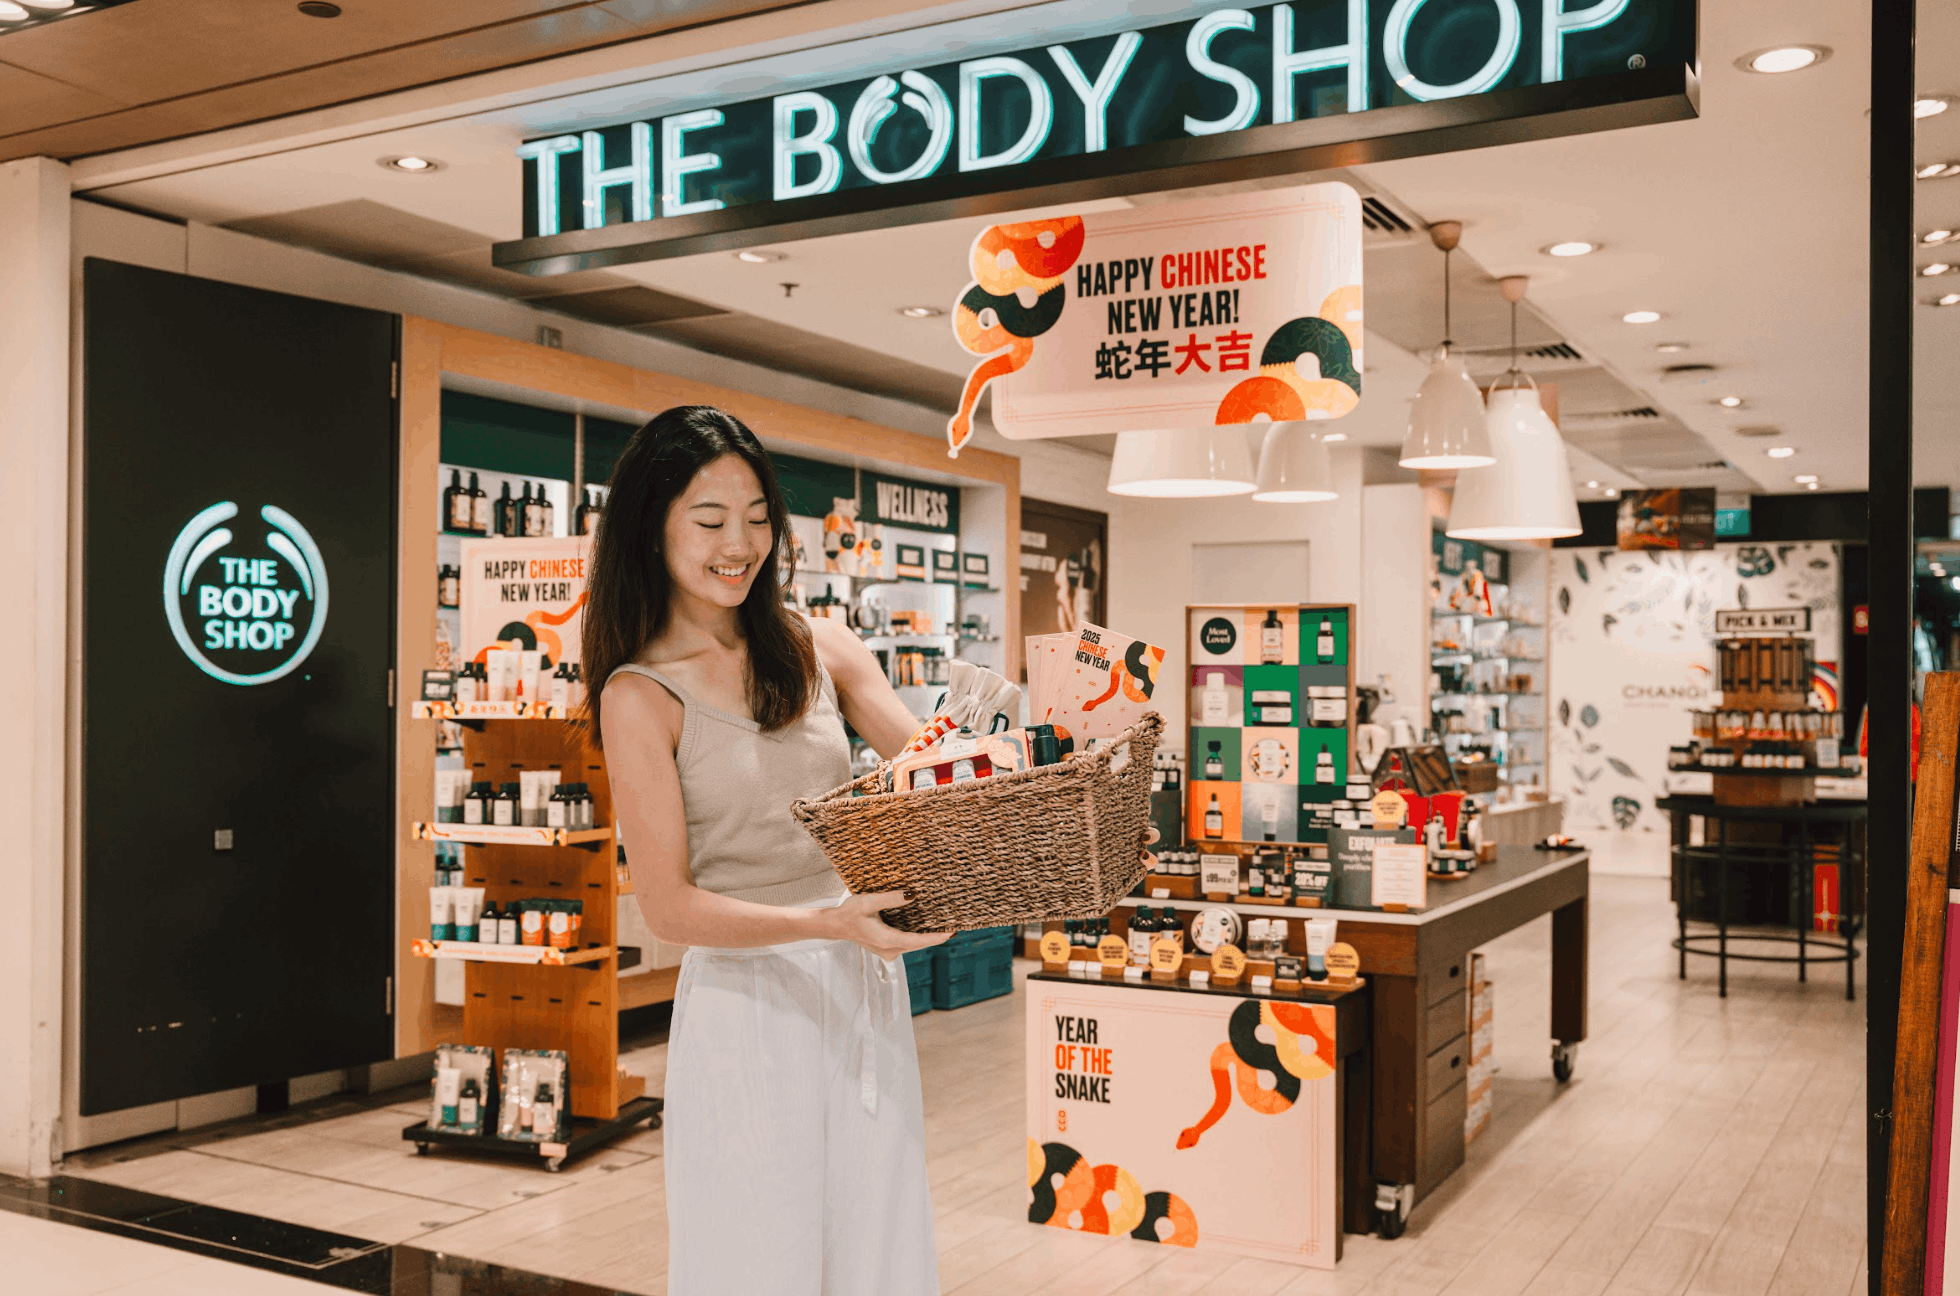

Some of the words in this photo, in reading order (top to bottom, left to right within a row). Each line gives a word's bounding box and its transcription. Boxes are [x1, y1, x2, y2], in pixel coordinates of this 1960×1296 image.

[515, 108, 725, 237] THE
[773, 31, 1144, 202] BODY
[1183, 0, 1630, 137] SHOP
[1077, 256, 1154, 298] HAPPY
[1160, 244, 1267, 289] CHINESE
[1108, 296, 1162, 335] NEW
[1169, 289, 1240, 329] YEAR!
[1094, 329, 1253, 380] 蛇年大吉
[877, 481, 949, 528] WELLNESS
[218, 556, 278, 586] THE
[484, 561, 526, 579] HAPPY
[529, 558, 585, 578] CHINESE
[199, 584, 300, 619] BODY
[501, 583, 530, 602] NEW
[534, 582, 571, 602] YEAR!
[204, 618, 295, 650] SHOP
[1208, 627, 1228, 635] Most
[1726, 615, 1753, 627] PICK
[1773, 614, 1795, 626] MIX
[1078, 639, 1108, 659] CHINESE
[1081, 629, 1101, 644] 2025
[1206, 634, 1231, 643] Loved
[1075, 650, 1093, 665] NEW
[1092, 656, 1111, 672] YEAR
[1055, 1015, 1098, 1044] YEAR
[1055, 1044, 1076, 1071] OF
[1080, 1046, 1112, 1075] THE
[1055, 1072, 1111, 1104] SNAKE
